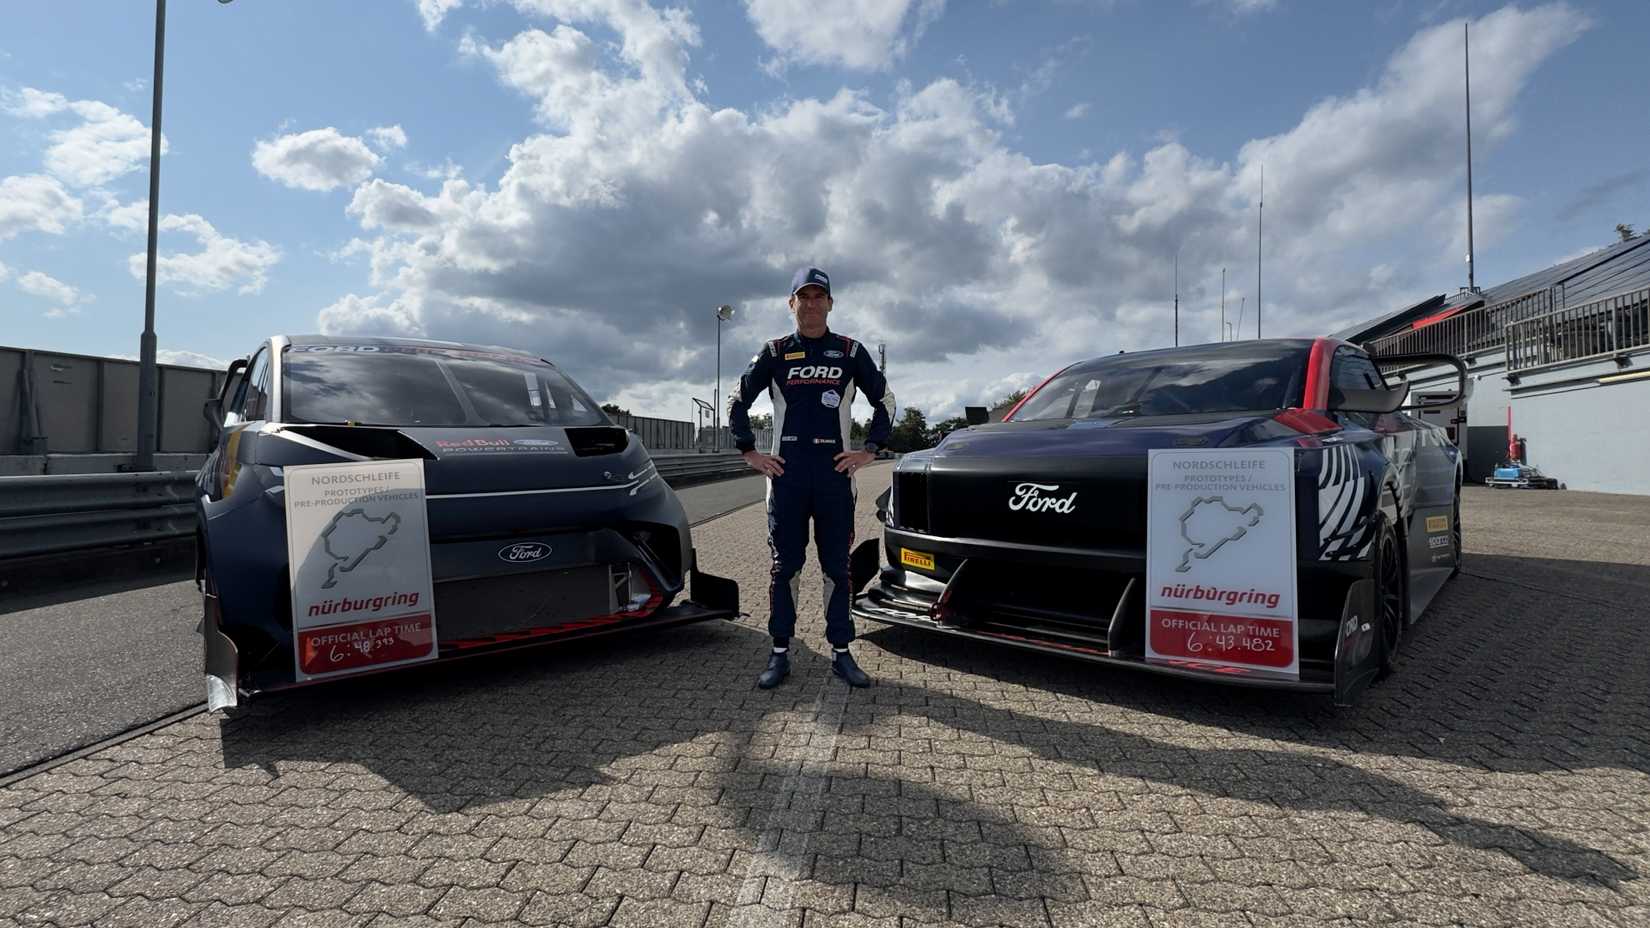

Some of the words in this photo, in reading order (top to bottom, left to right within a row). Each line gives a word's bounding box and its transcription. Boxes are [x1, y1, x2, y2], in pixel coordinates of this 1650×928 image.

[787, 365, 843, 380] FORD
[1172, 459, 1265, 470] NORDSCHLEIFE
[311, 471, 401, 486] NORDSCHLEIFE
[1184, 474, 1246, 483] PROTOTYPES
[324, 486, 384, 497] PROTOTYPES
[1155, 482, 1238, 492] PRE-PRODUCTION
[1239, 483, 1287, 492] VEHICLES
[294, 495, 377, 509] PRE-PRODUCTION
[1008, 482, 1078, 514] Ford
[508, 544, 543, 560] Ford
[903, 551, 932, 567] PIRELLI
[1161, 583, 1281, 609] nürburgring
[308, 591, 420, 617] nürburgring
[311, 631, 367, 647] OFFICIAL
[369, 627, 392, 638] LAP
[393, 622, 421, 634] TIME
[1161, 618, 1217, 633] OFFICIAL
[1220, 623, 1246, 635] LAP
[1247, 625, 1281, 638] TIME
